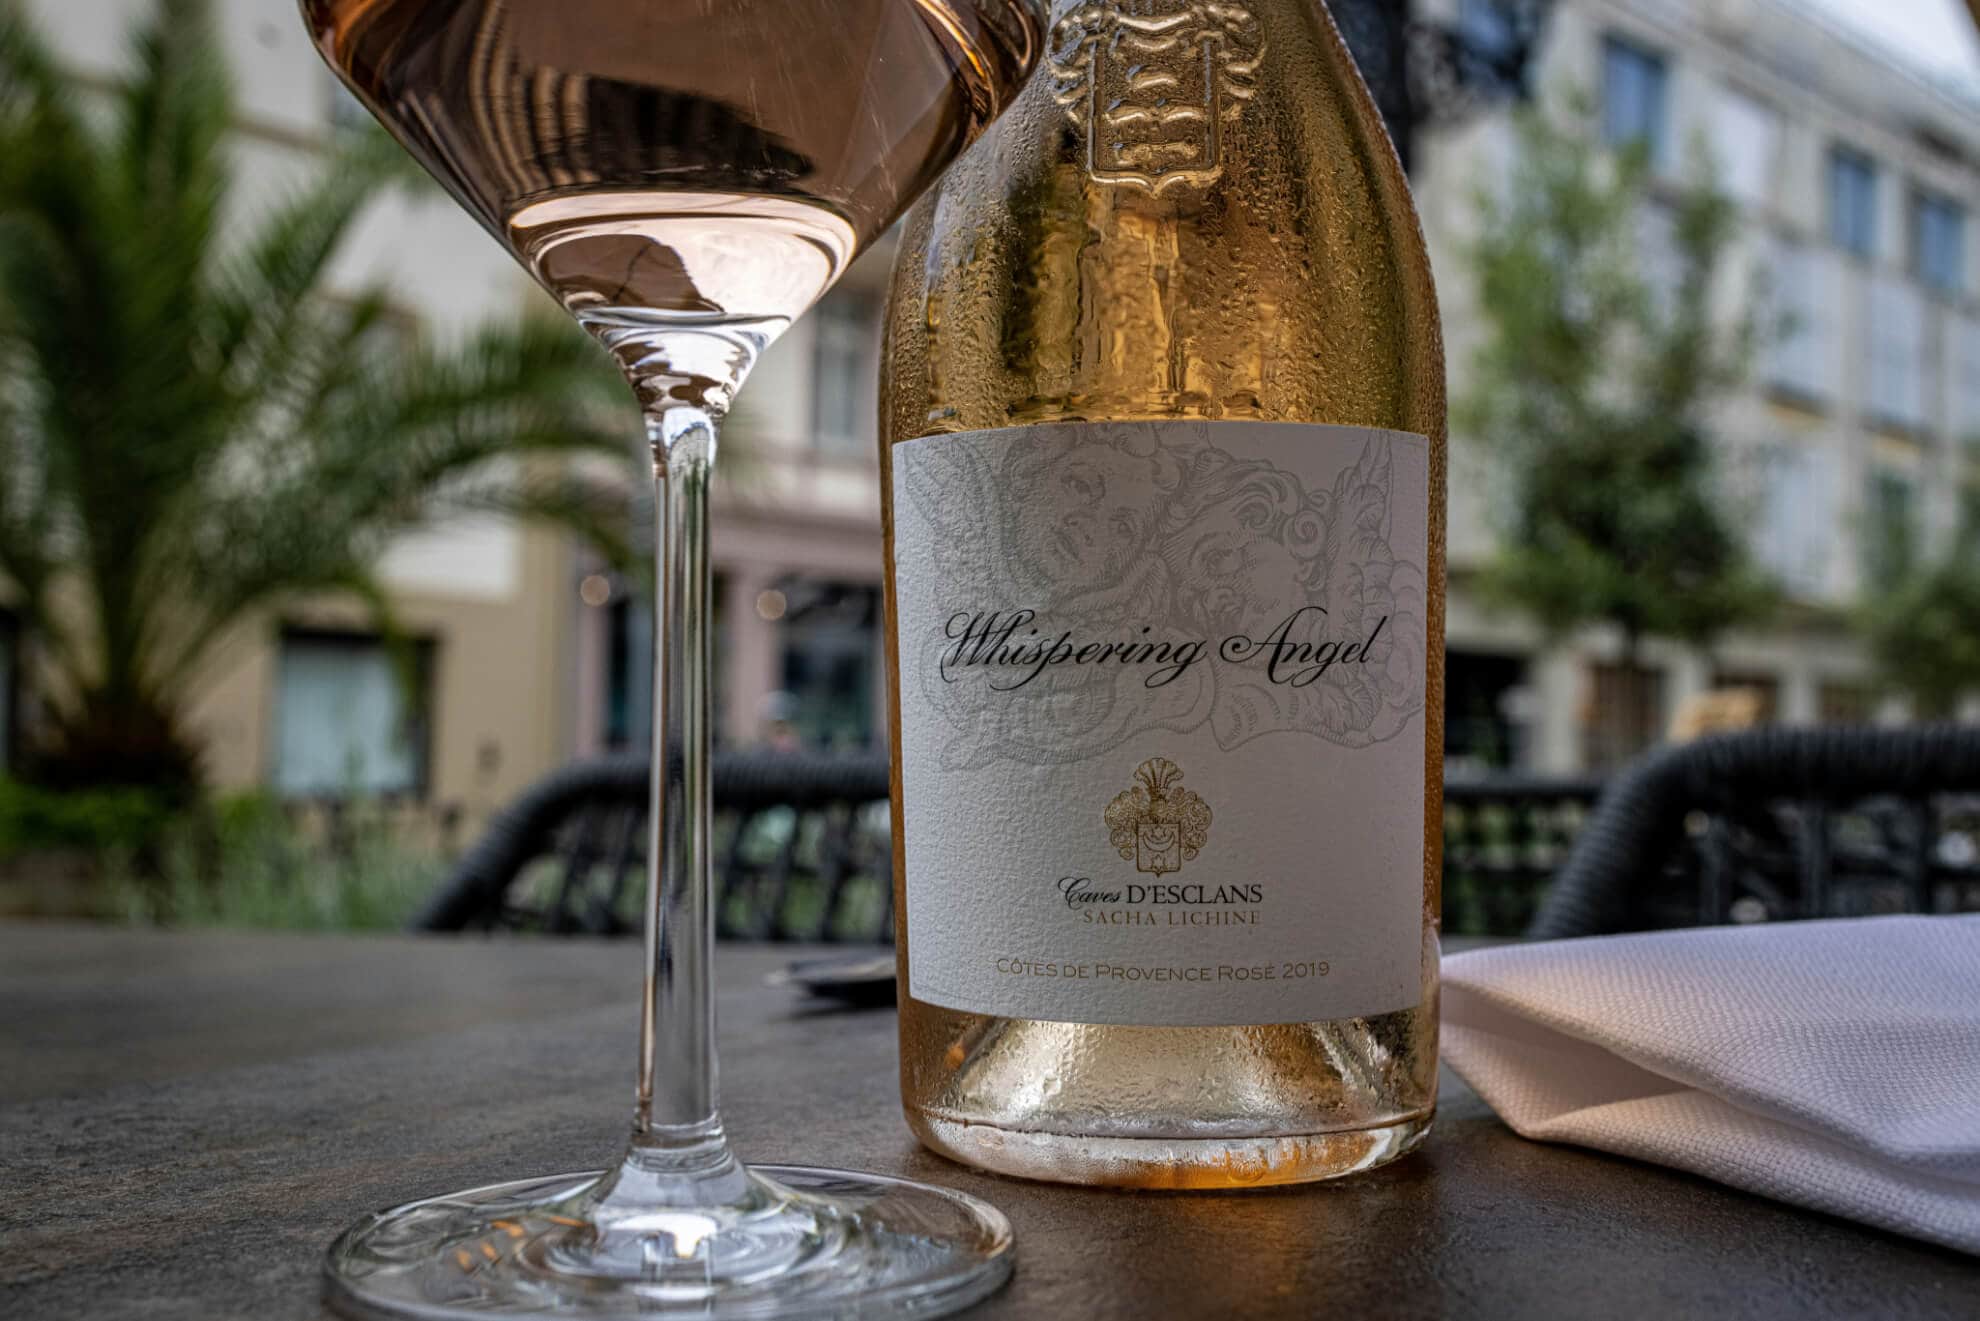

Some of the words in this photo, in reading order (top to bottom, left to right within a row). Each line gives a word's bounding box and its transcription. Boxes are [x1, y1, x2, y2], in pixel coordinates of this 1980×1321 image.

[940, 608, 1207, 691] Whispering
[1219, 606, 1388, 687] Angel
[1057, 876, 1121, 910] Caves
[1126, 884, 1263, 905] D'ESCLANS
[1082, 909, 1157, 926] SACHA
[1168, 909, 1261, 927] LICHINE
[996, 957, 1058, 977] CÔTES
[1063, 963, 1089, 979] DE
[1095, 963, 1212, 982] PROVENCE
[1218, 962, 1276, 981] ROSÉ
[1282, 960, 1331, 979] 2019
